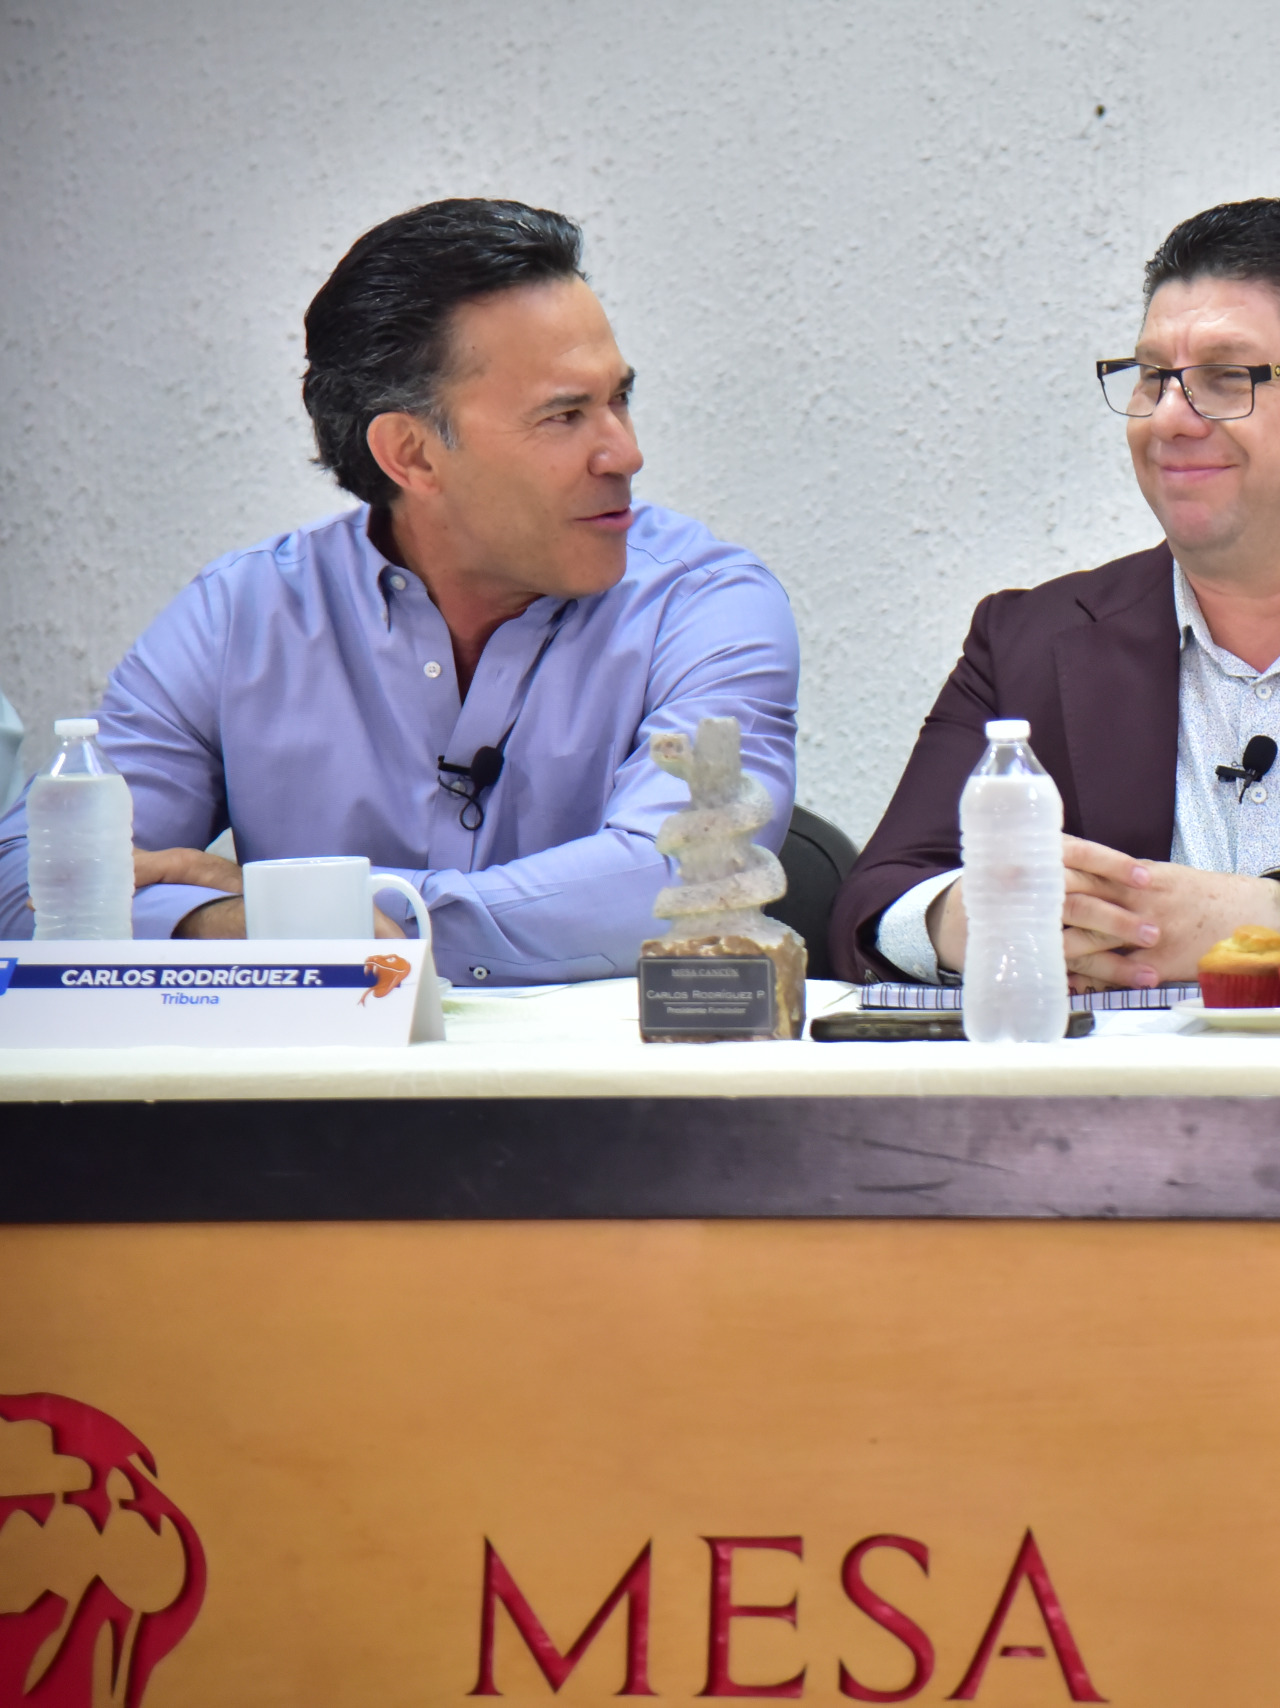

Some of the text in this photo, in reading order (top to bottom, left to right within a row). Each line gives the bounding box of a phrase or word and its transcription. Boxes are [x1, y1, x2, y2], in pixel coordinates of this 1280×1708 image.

[61, 966, 322, 986] CARLOS RODRÍGUEZ F.
[160, 993, 219, 1005] Tribuna
[465, 1525, 1111, 1703] MESA
